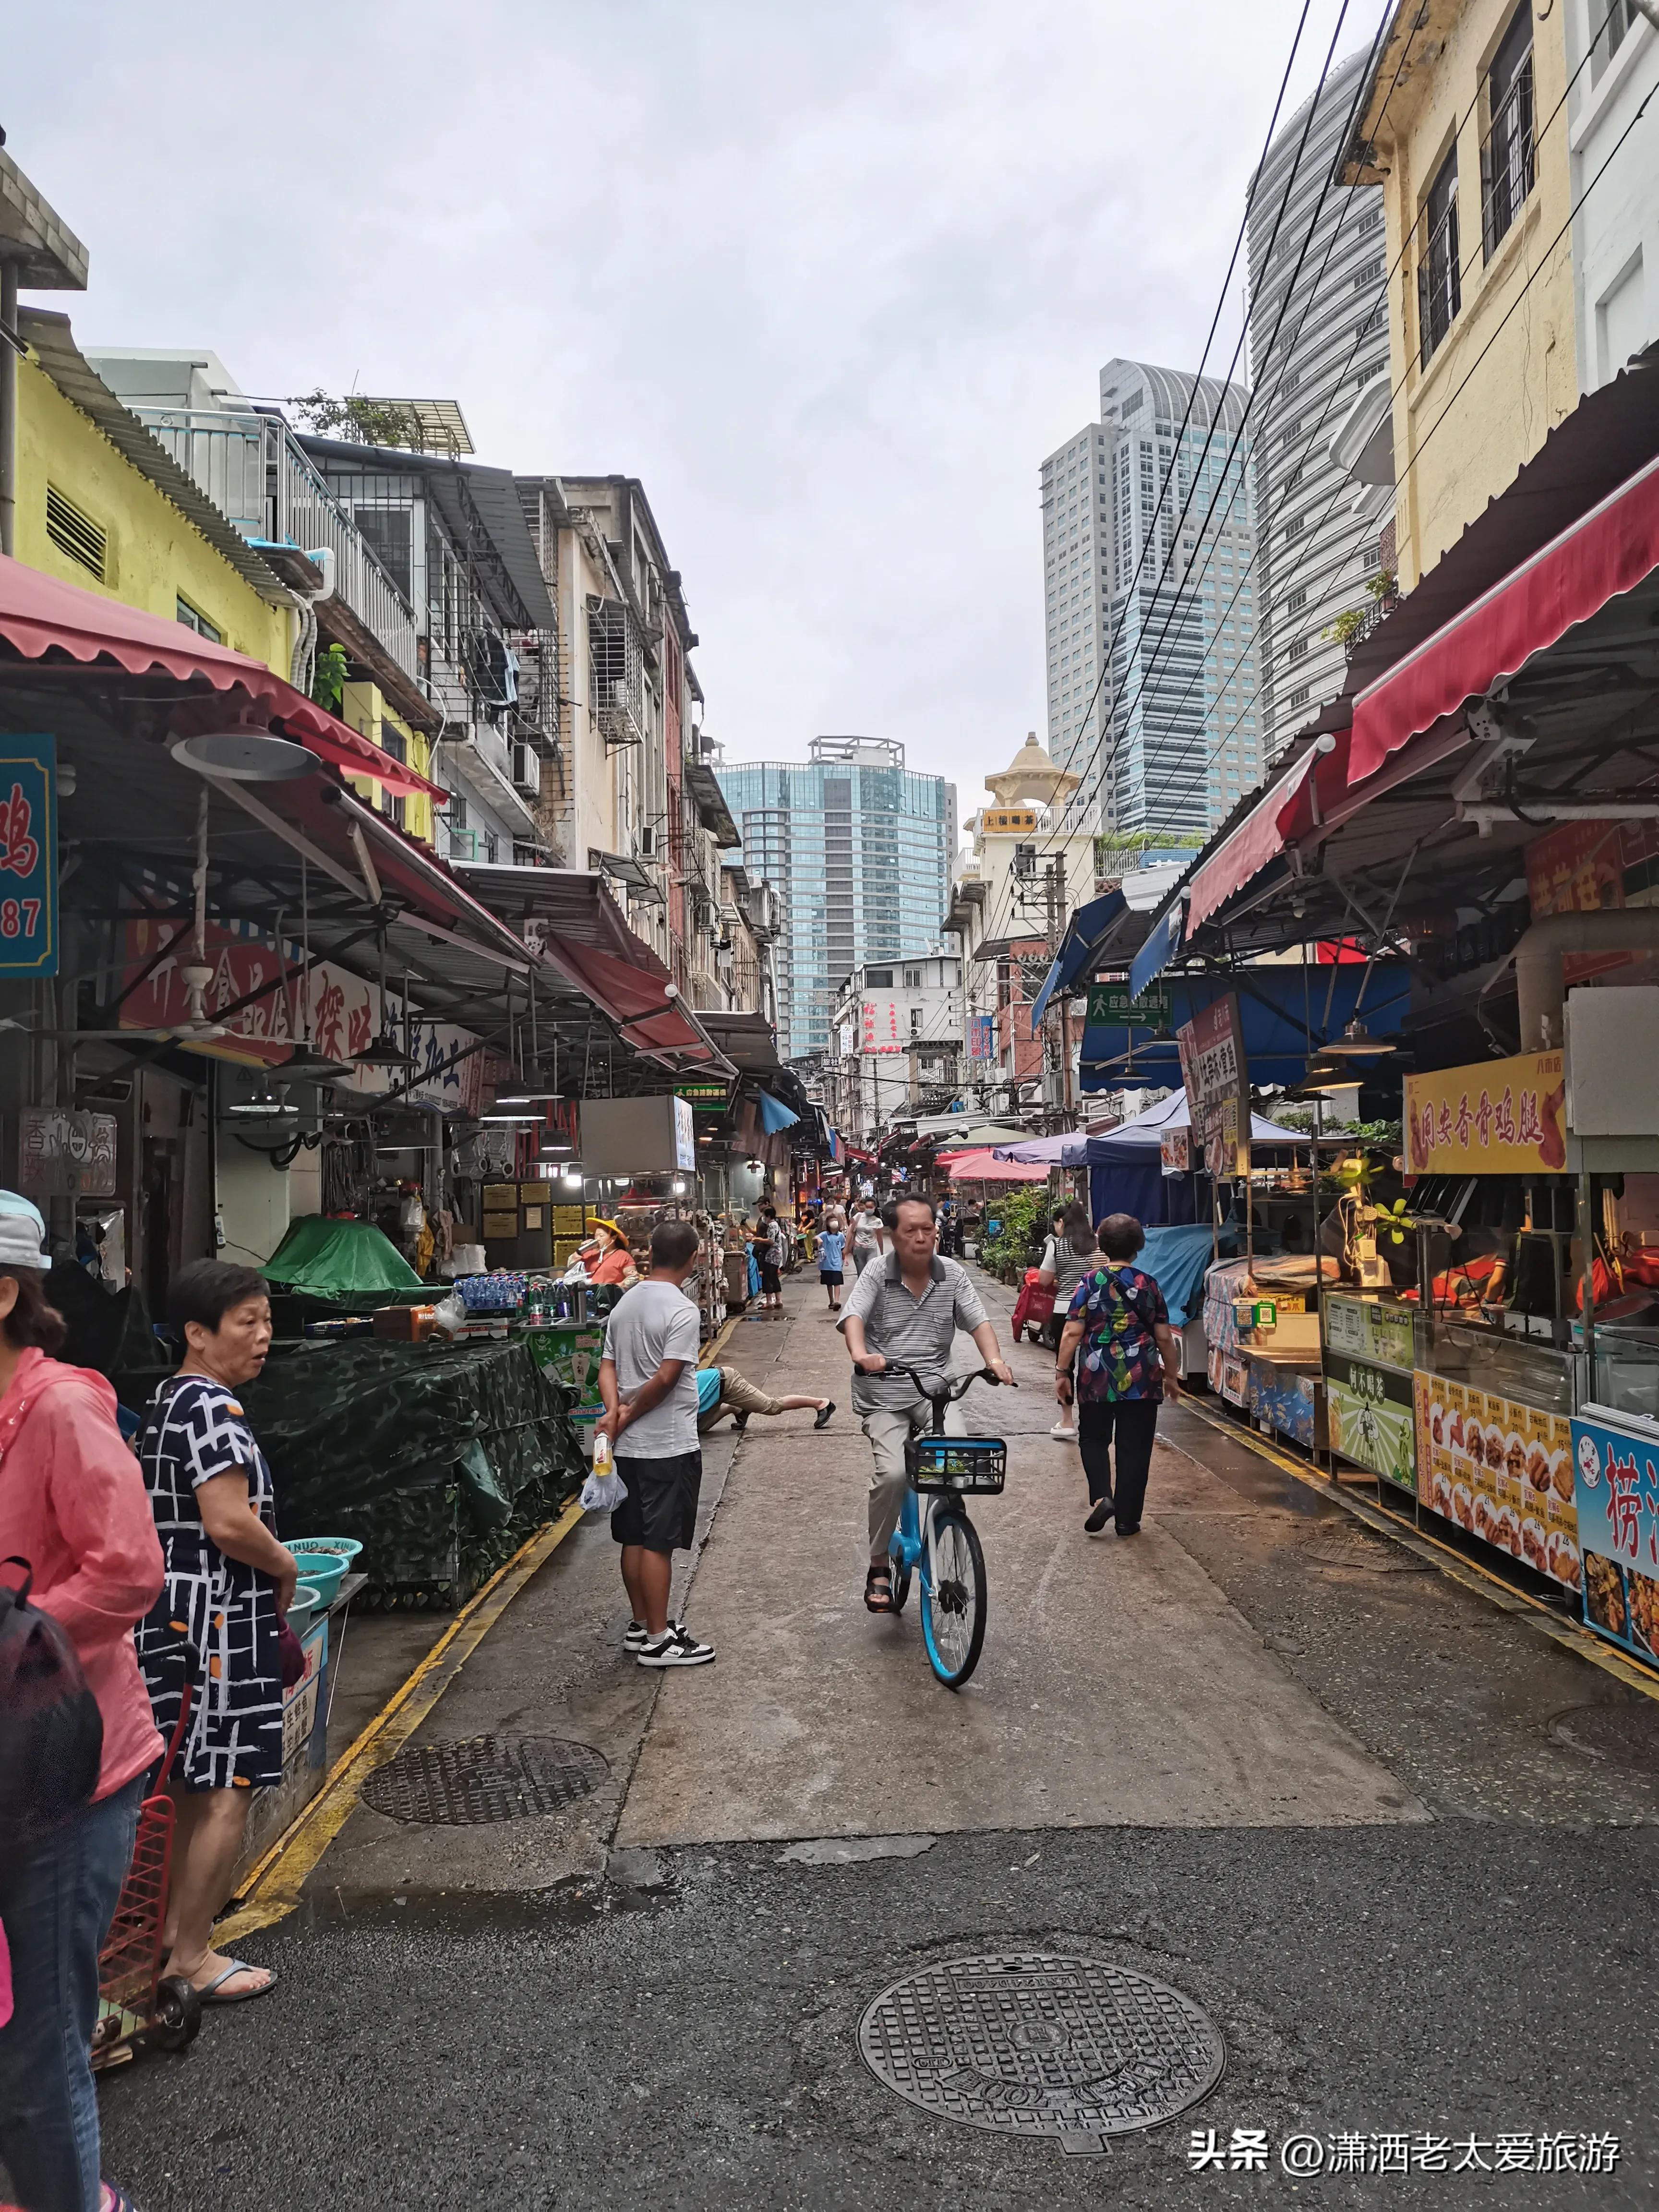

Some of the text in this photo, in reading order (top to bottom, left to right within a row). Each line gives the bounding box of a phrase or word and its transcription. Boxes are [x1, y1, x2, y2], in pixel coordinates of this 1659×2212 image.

[1, 898, 41, 938] 87
[971, 1018, 981, 1056] 八市印象
[1537, 1057, 1562, 1075] 八市店
[1421, 1084, 1545, 1151] 同安香骨鸡腿
